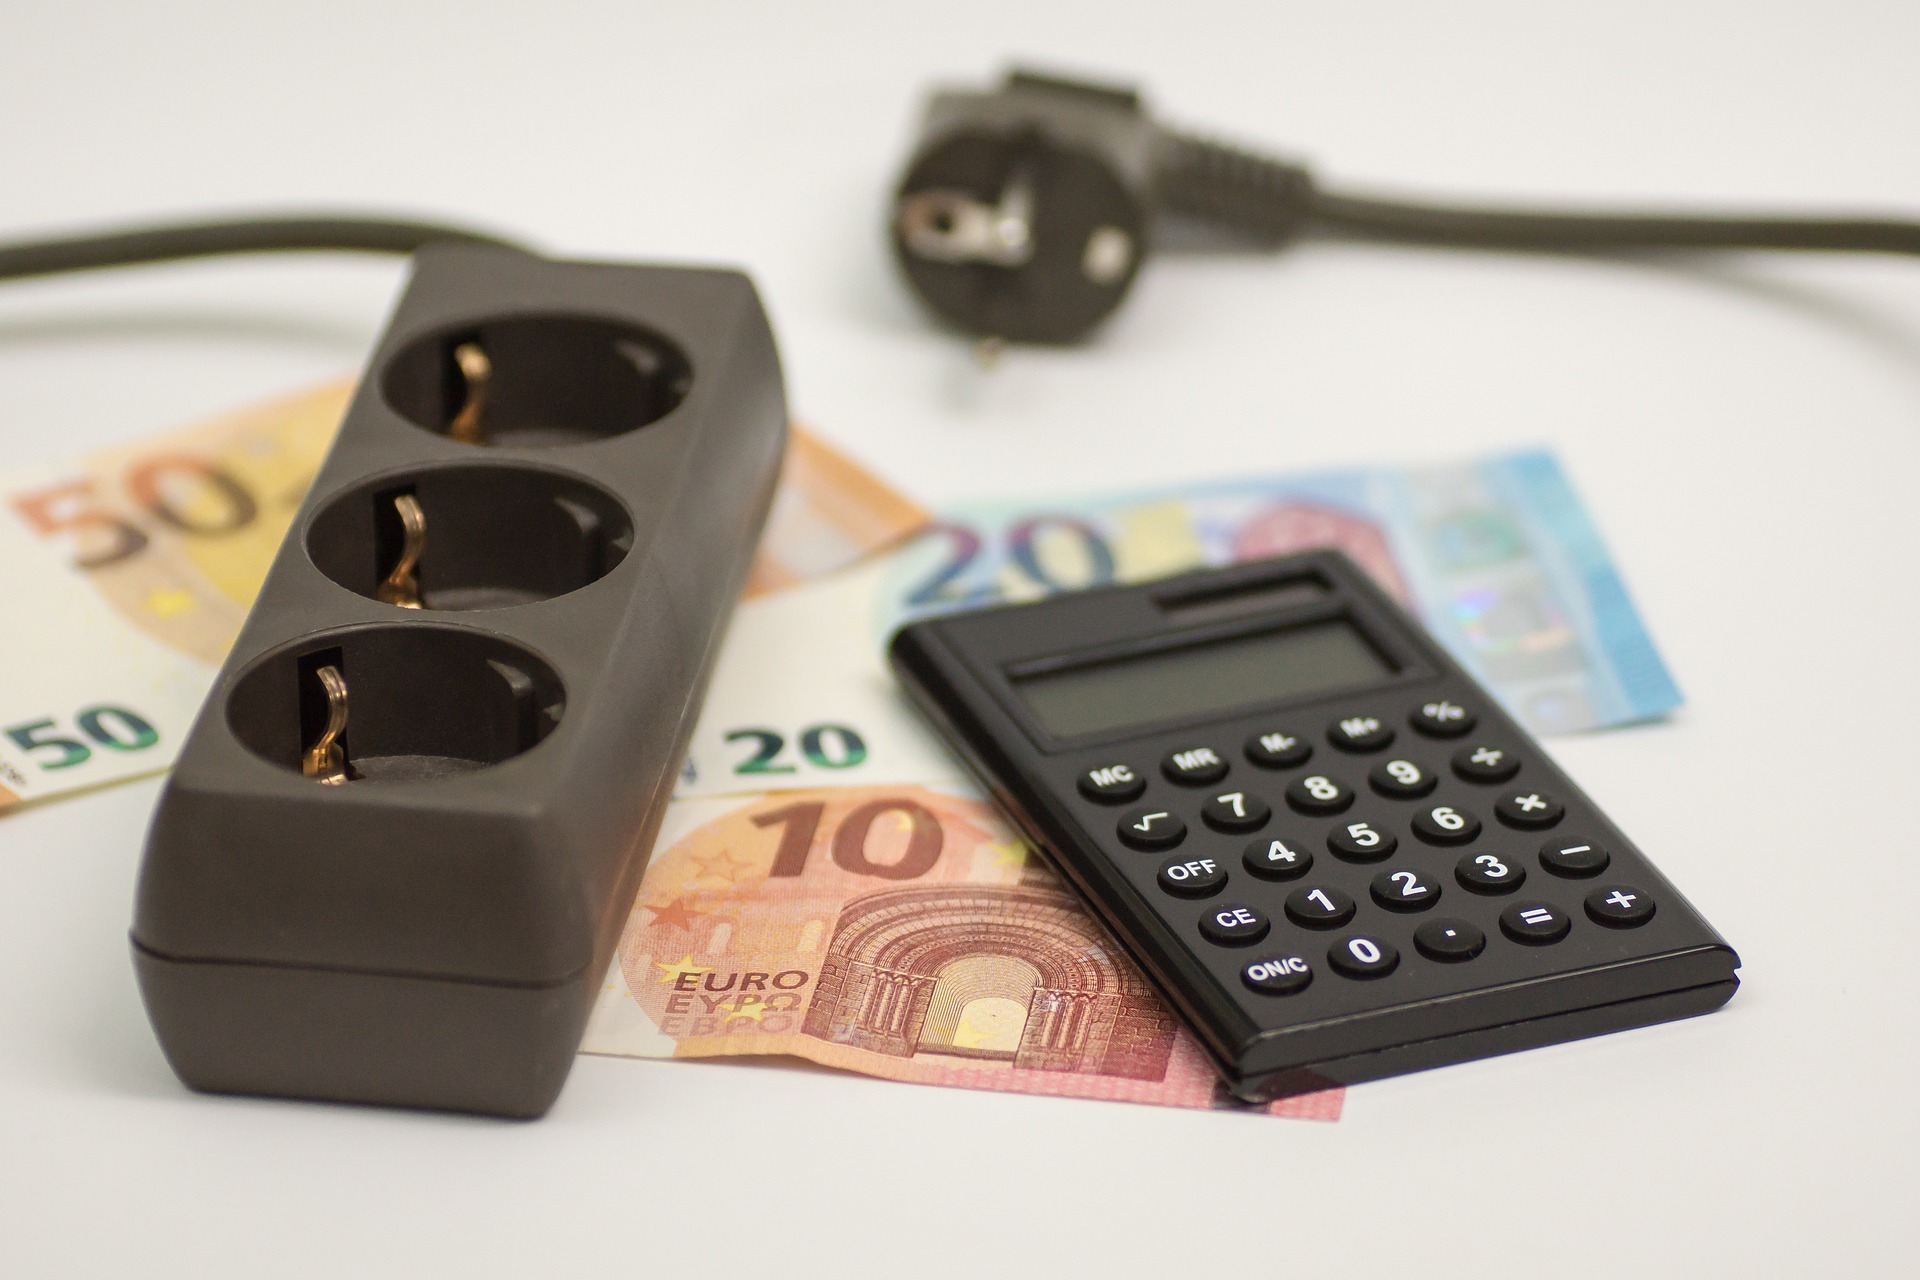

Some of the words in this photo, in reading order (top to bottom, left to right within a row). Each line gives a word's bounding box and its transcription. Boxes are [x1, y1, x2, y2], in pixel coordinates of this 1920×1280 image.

[12, 454, 257, 570] 50
[901, 514, 1115, 605] 20
[1423, 701, 1465, 721] %
[4, 706, 160, 769] 50
[1340, 717, 1379, 737] M+
[724, 723, 869, 774] 20
[1260, 733, 1295, 752] M-
[1172, 747, 1219, 770] MR
[1089, 764, 1134, 787] MC
[1386, 759, 1421, 785] 9
[1303, 775, 1339, 800] 8
[1217, 792, 1246, 817] 7
[1431, 806, 1465, 830] 6
[749, 801, 944, 881] 10
[1347, 822, 1380, 847] 5
[1267, 840, 1297, 863] 4
[1167, 858, 1217, 881] OFF
[1475, 854, 1509, 878] 3
[1390, 871, 1428, 897] 2
[1307, 888, 1336, 912] 1
[1216, 904, 1257, 928] CE
[1348, 938, 1381, 964] 0
[673, 970, 809, 992] EURO
[1247, 957, 1308, 981] ON/C
